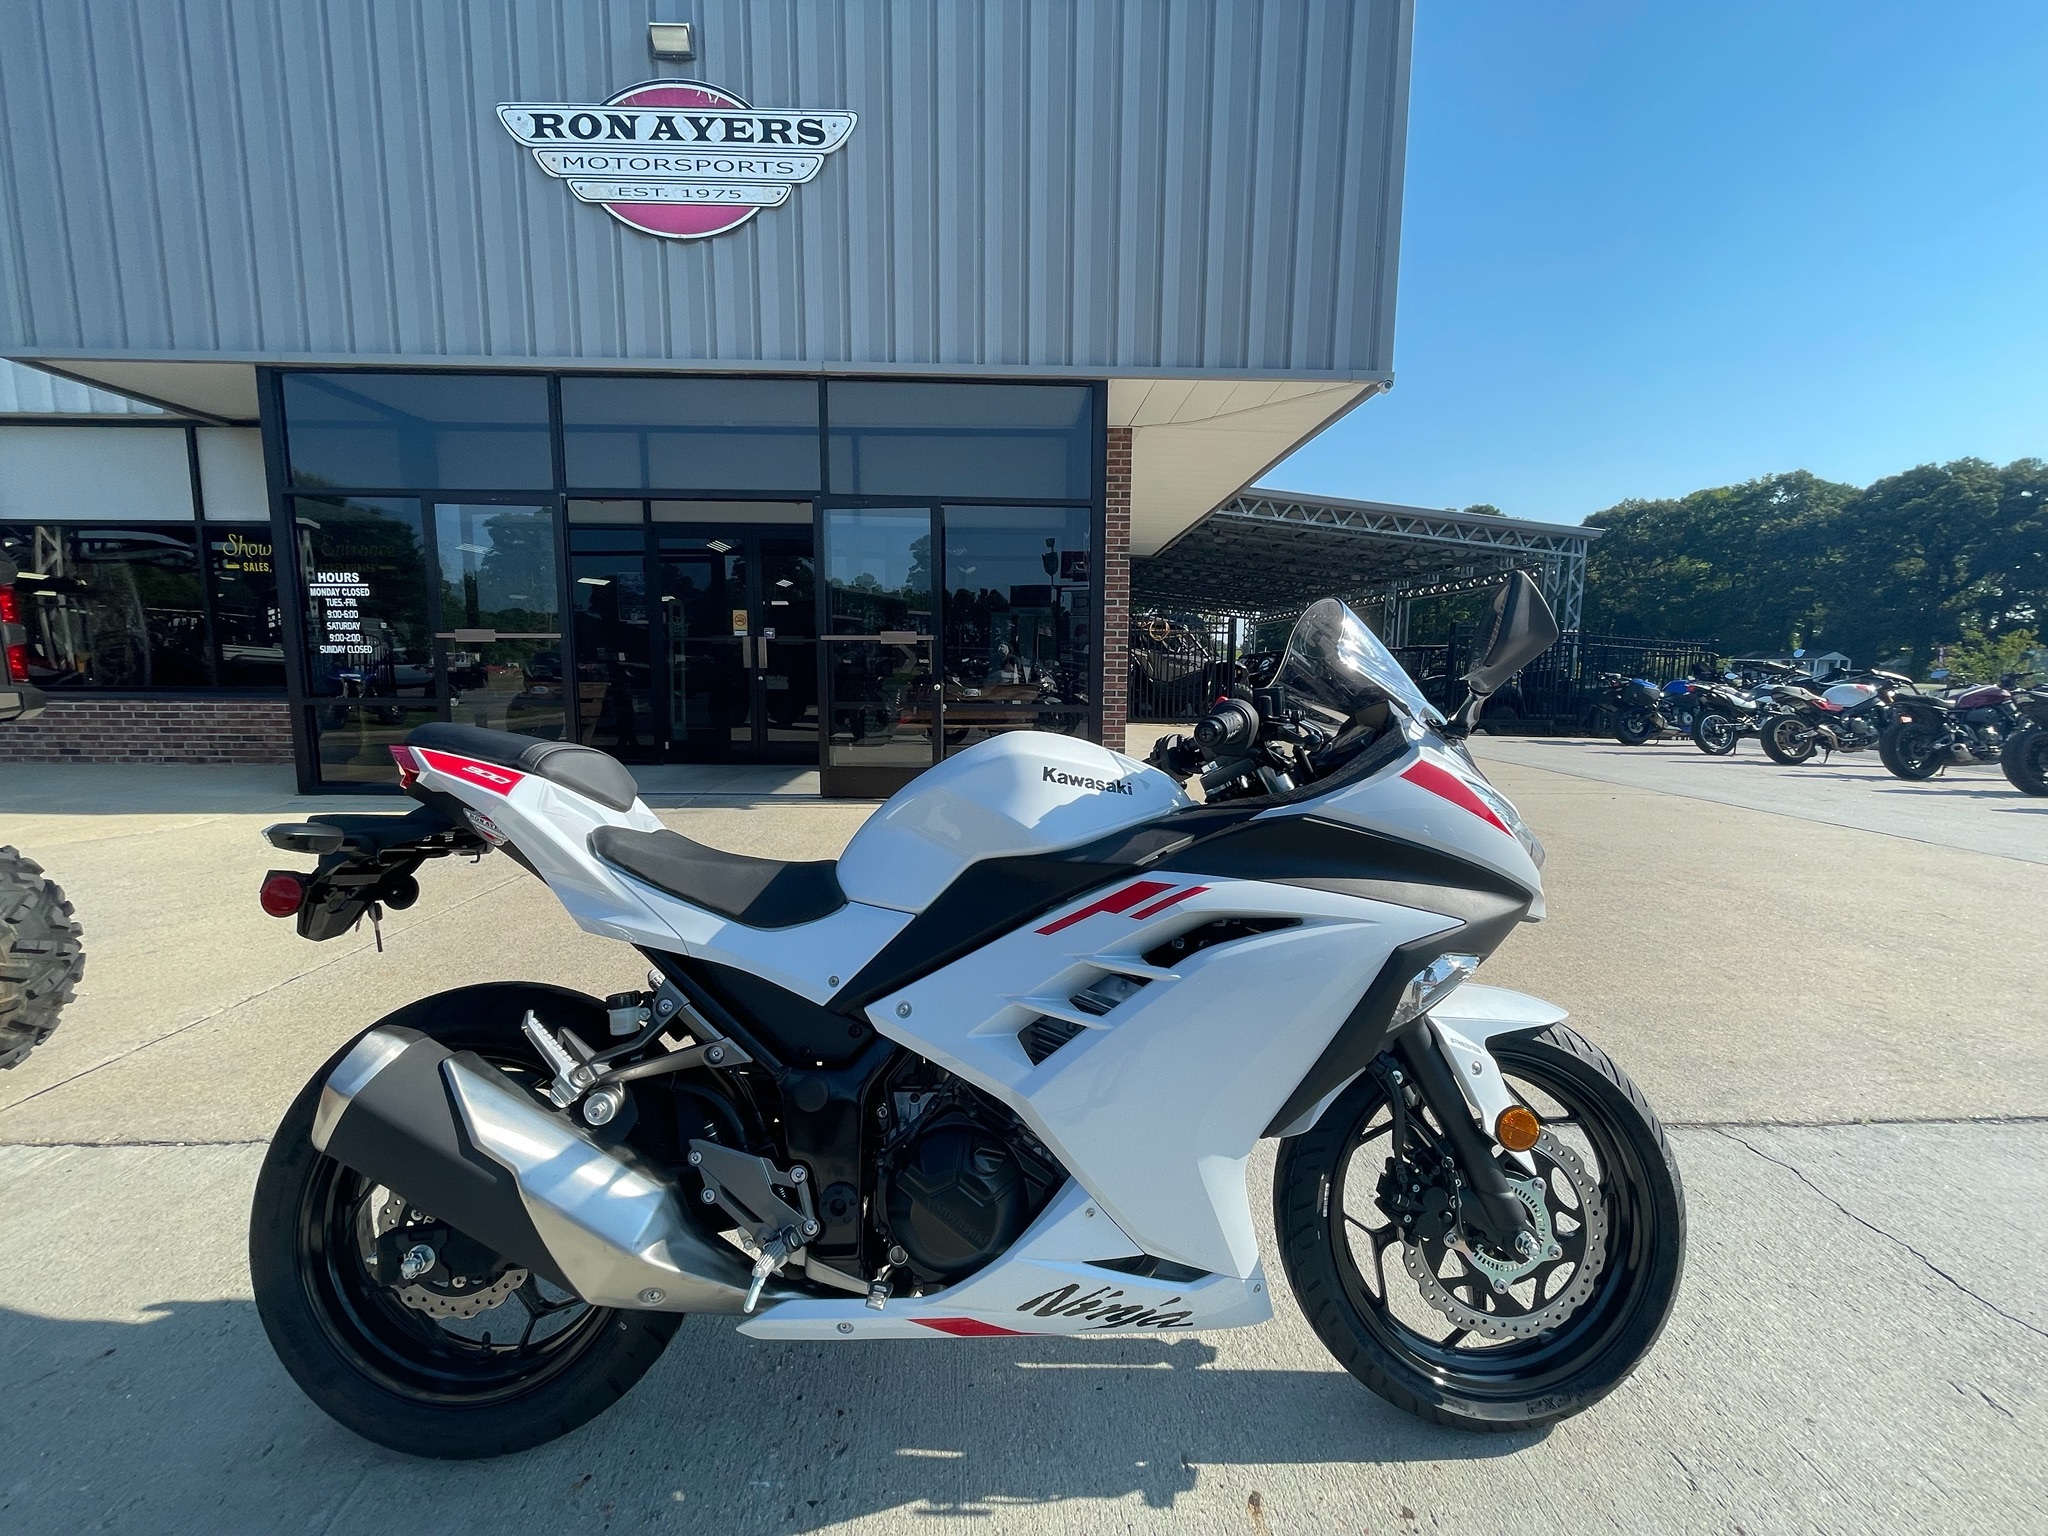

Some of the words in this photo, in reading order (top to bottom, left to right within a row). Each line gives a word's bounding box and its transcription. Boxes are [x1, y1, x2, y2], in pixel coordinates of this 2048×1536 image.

[528, 113, 642, 140] RON
[648, 116, 826, 146] AYERS
[563, 156, 794, 174] MOTORSPORTS
[618, 187, 668, 198] EST.
[682, 188, 742, 199] 1975
[222, 533, 272, 558] Show
[317, 572, 360, 583] HOURS
[309, 588, 340, 597] MONDAY
[341, 588, 370, 597] CLOSED
[326, 621, 361, 630] SATURDAY
[319, 645, 346, 654] SUNDAY
[346, 645, 373, 654] CLOSED
[1042, 766, 1134, 796] Kawasaki
[1016, 1284, 1195, 1332] Ninja
